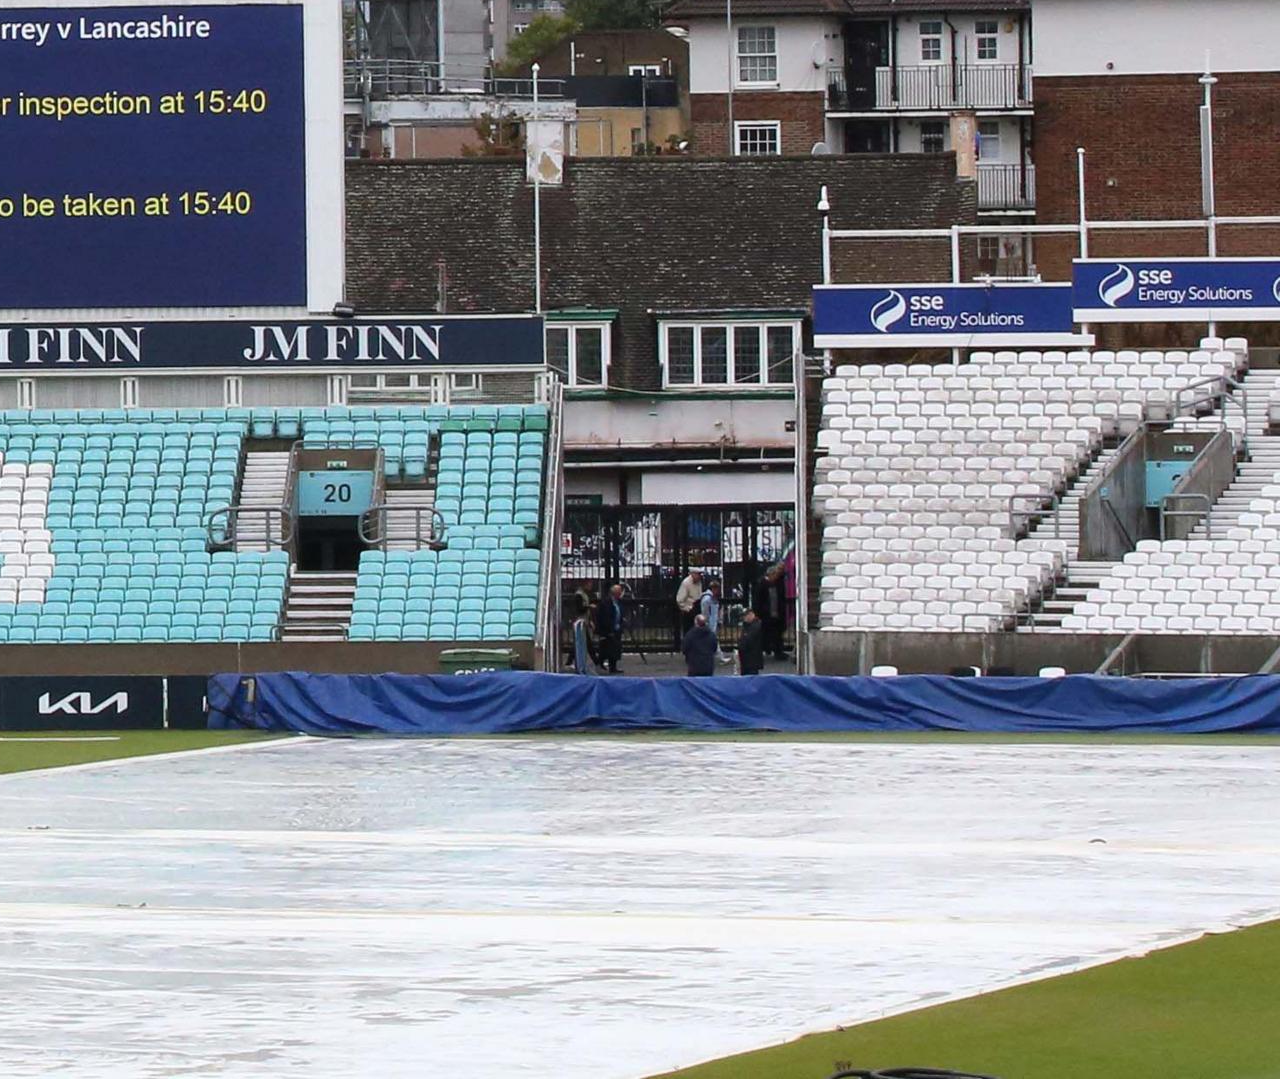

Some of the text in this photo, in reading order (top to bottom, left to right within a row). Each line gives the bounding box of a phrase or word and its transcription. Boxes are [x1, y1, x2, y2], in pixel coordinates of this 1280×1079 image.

[56, 22, 72, 39] v
[80, 14, 210, 39] Lancashire
[19, 91, 150, 121] inspection
[159, 91, 185, 114] at
[194, 89, 266, 113] 15:40
[23, 193, 55, 217] be
[62, 192, 135, 216] taken
[144, 193, 170, 215] at
[178, 191, 251, 215] 15:40
[1138, 269, 1172, 285] sse
[910, 295, 944, 310] sse
[1138, 286, 1253, 304] Energy Solutions
[910, 311, 1024, 330] Energy Solutions
[25, 327, 144, 363] FINN
[243, 325, 443, 361] JM FINN
[324, 483, 351, 503] 20
